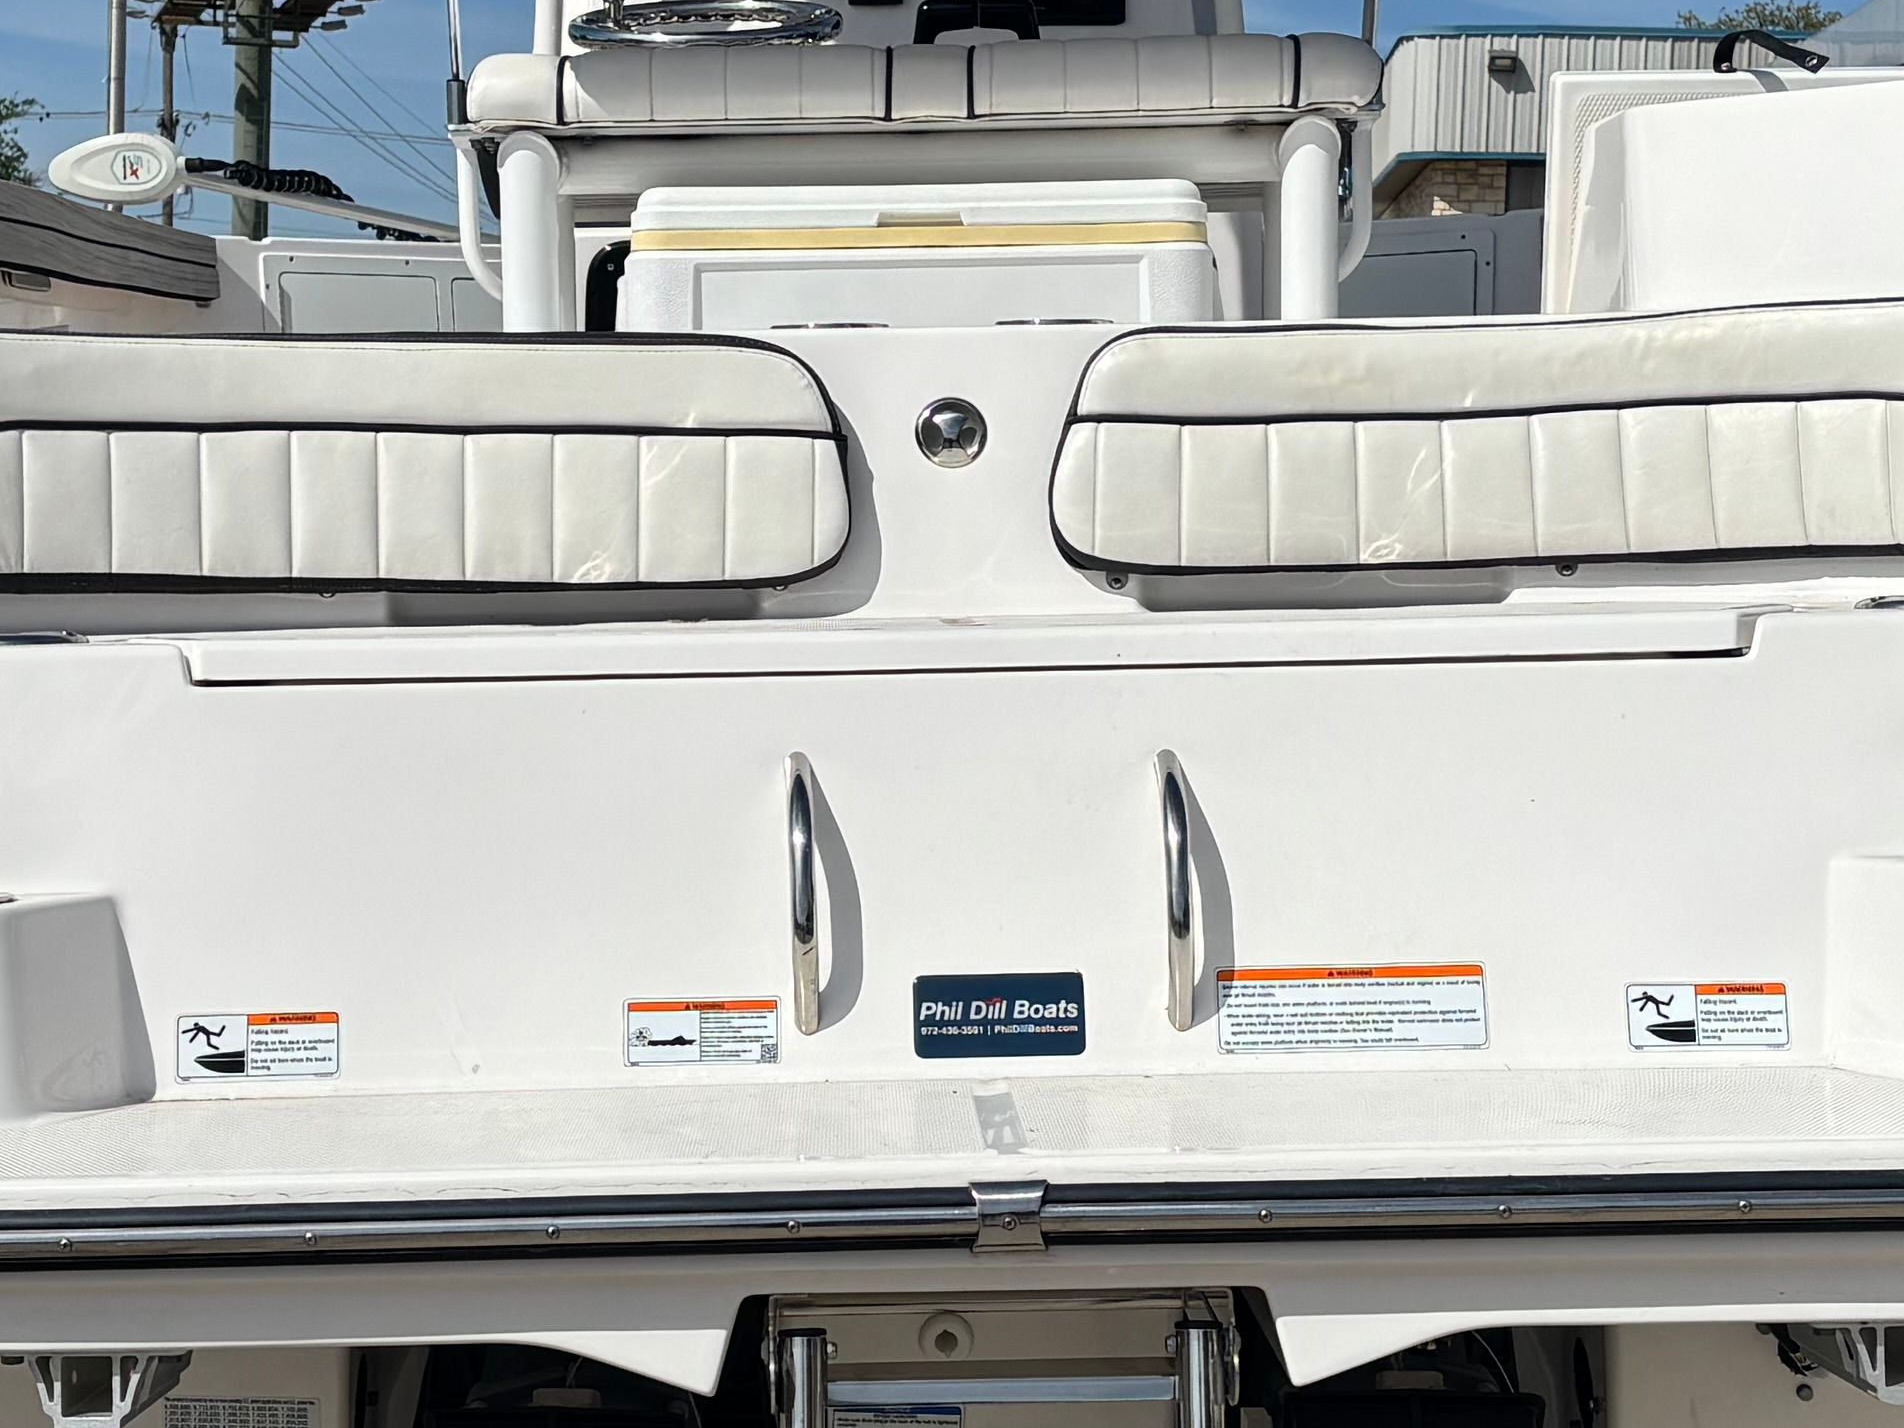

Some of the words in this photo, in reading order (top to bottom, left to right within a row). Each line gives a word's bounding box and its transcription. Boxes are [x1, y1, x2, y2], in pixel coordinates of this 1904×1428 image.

[919, 1001, 964, 1021] Phil
[969, 999, 1007, 1020] Dill
[1013, 999, 1079, 1019] Boats
